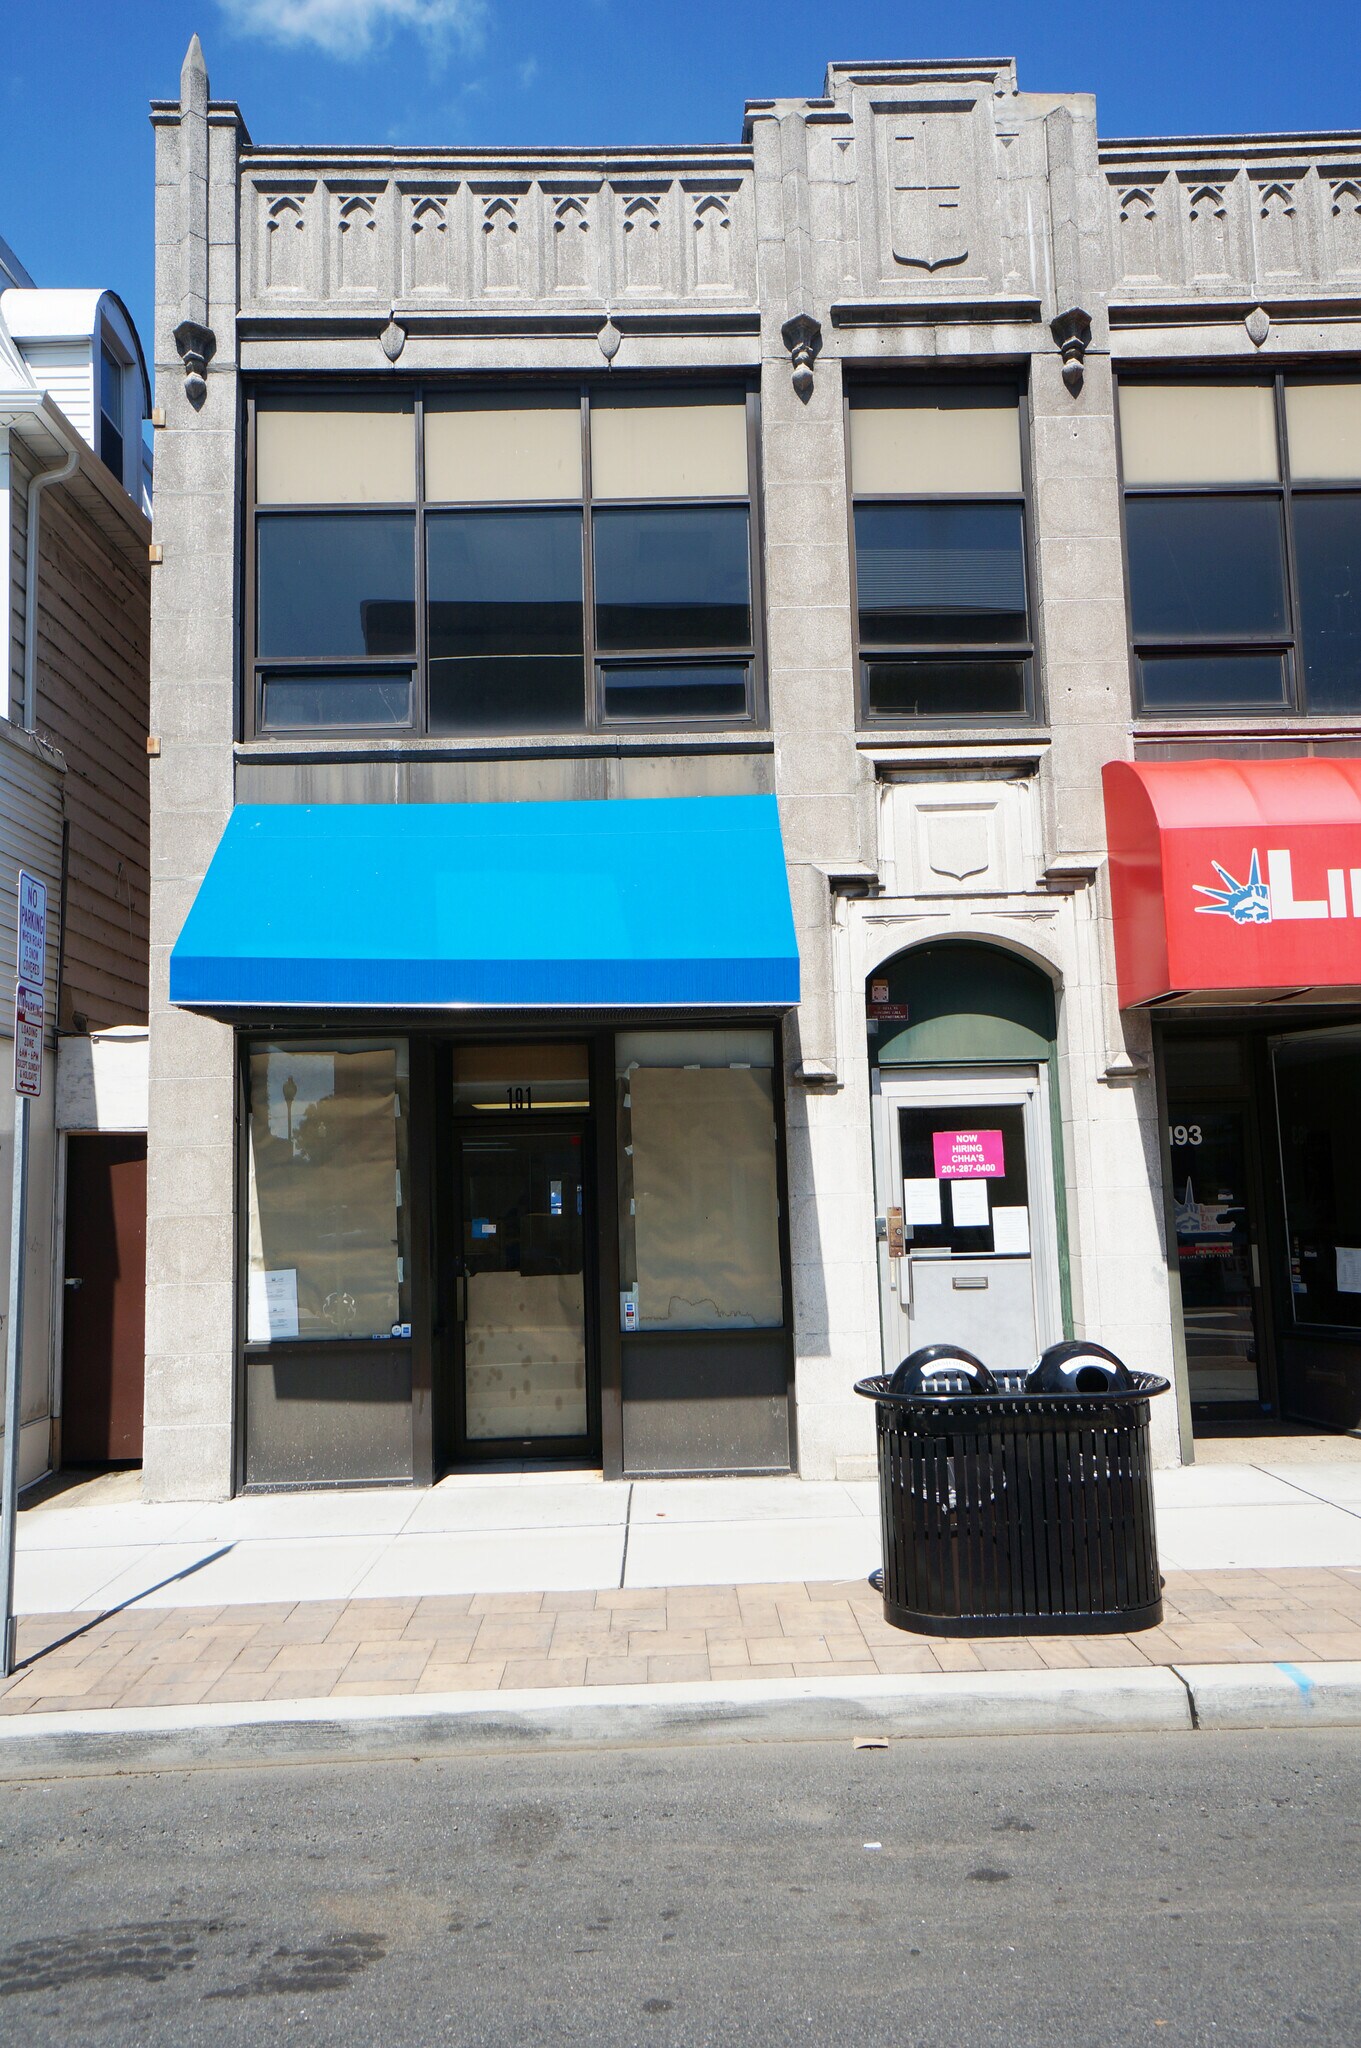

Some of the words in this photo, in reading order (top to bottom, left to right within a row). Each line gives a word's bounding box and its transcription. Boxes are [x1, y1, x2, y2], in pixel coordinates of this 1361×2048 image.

[27, 886, 38, 909] NO
[22, 905, 43, 935] PARKING
[29, 948, 38, 961] SNOW
[23, 959, 40, 976] COVERED
[21, 1025, 38, 1038] LOADING
[24, 1036, 34, 1048] ZONE
[506, 1086, 532, 1110] 191
[956, 1134, 978, 1143] NOW
[1168, 1125, 1202, 1146] 193
[952, 1144, 982, 1153] HIRING
[952, 1154, 985, 1163] CHHA'S
[942, 1164, 996, 1173] 201-287-0400
[1200, 1214, 1214, 1222] TAX
